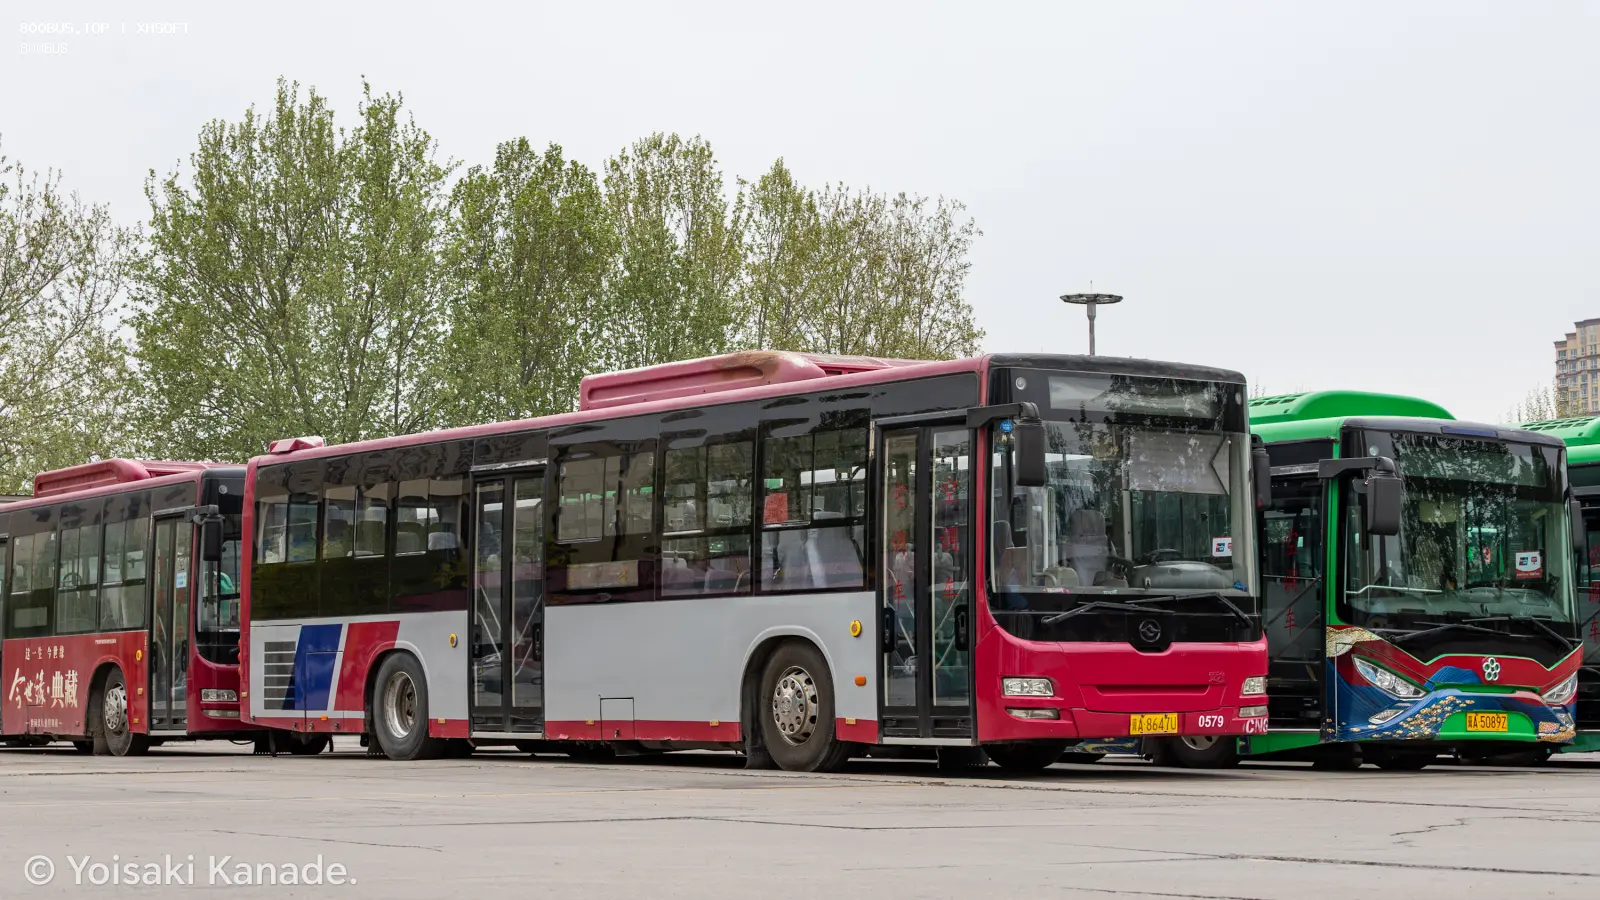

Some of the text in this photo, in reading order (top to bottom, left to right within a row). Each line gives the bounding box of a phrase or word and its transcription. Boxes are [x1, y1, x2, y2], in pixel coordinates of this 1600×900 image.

[939, 478, 959, 605] 空调车
[1198, 715, 1224, 728] 0579
